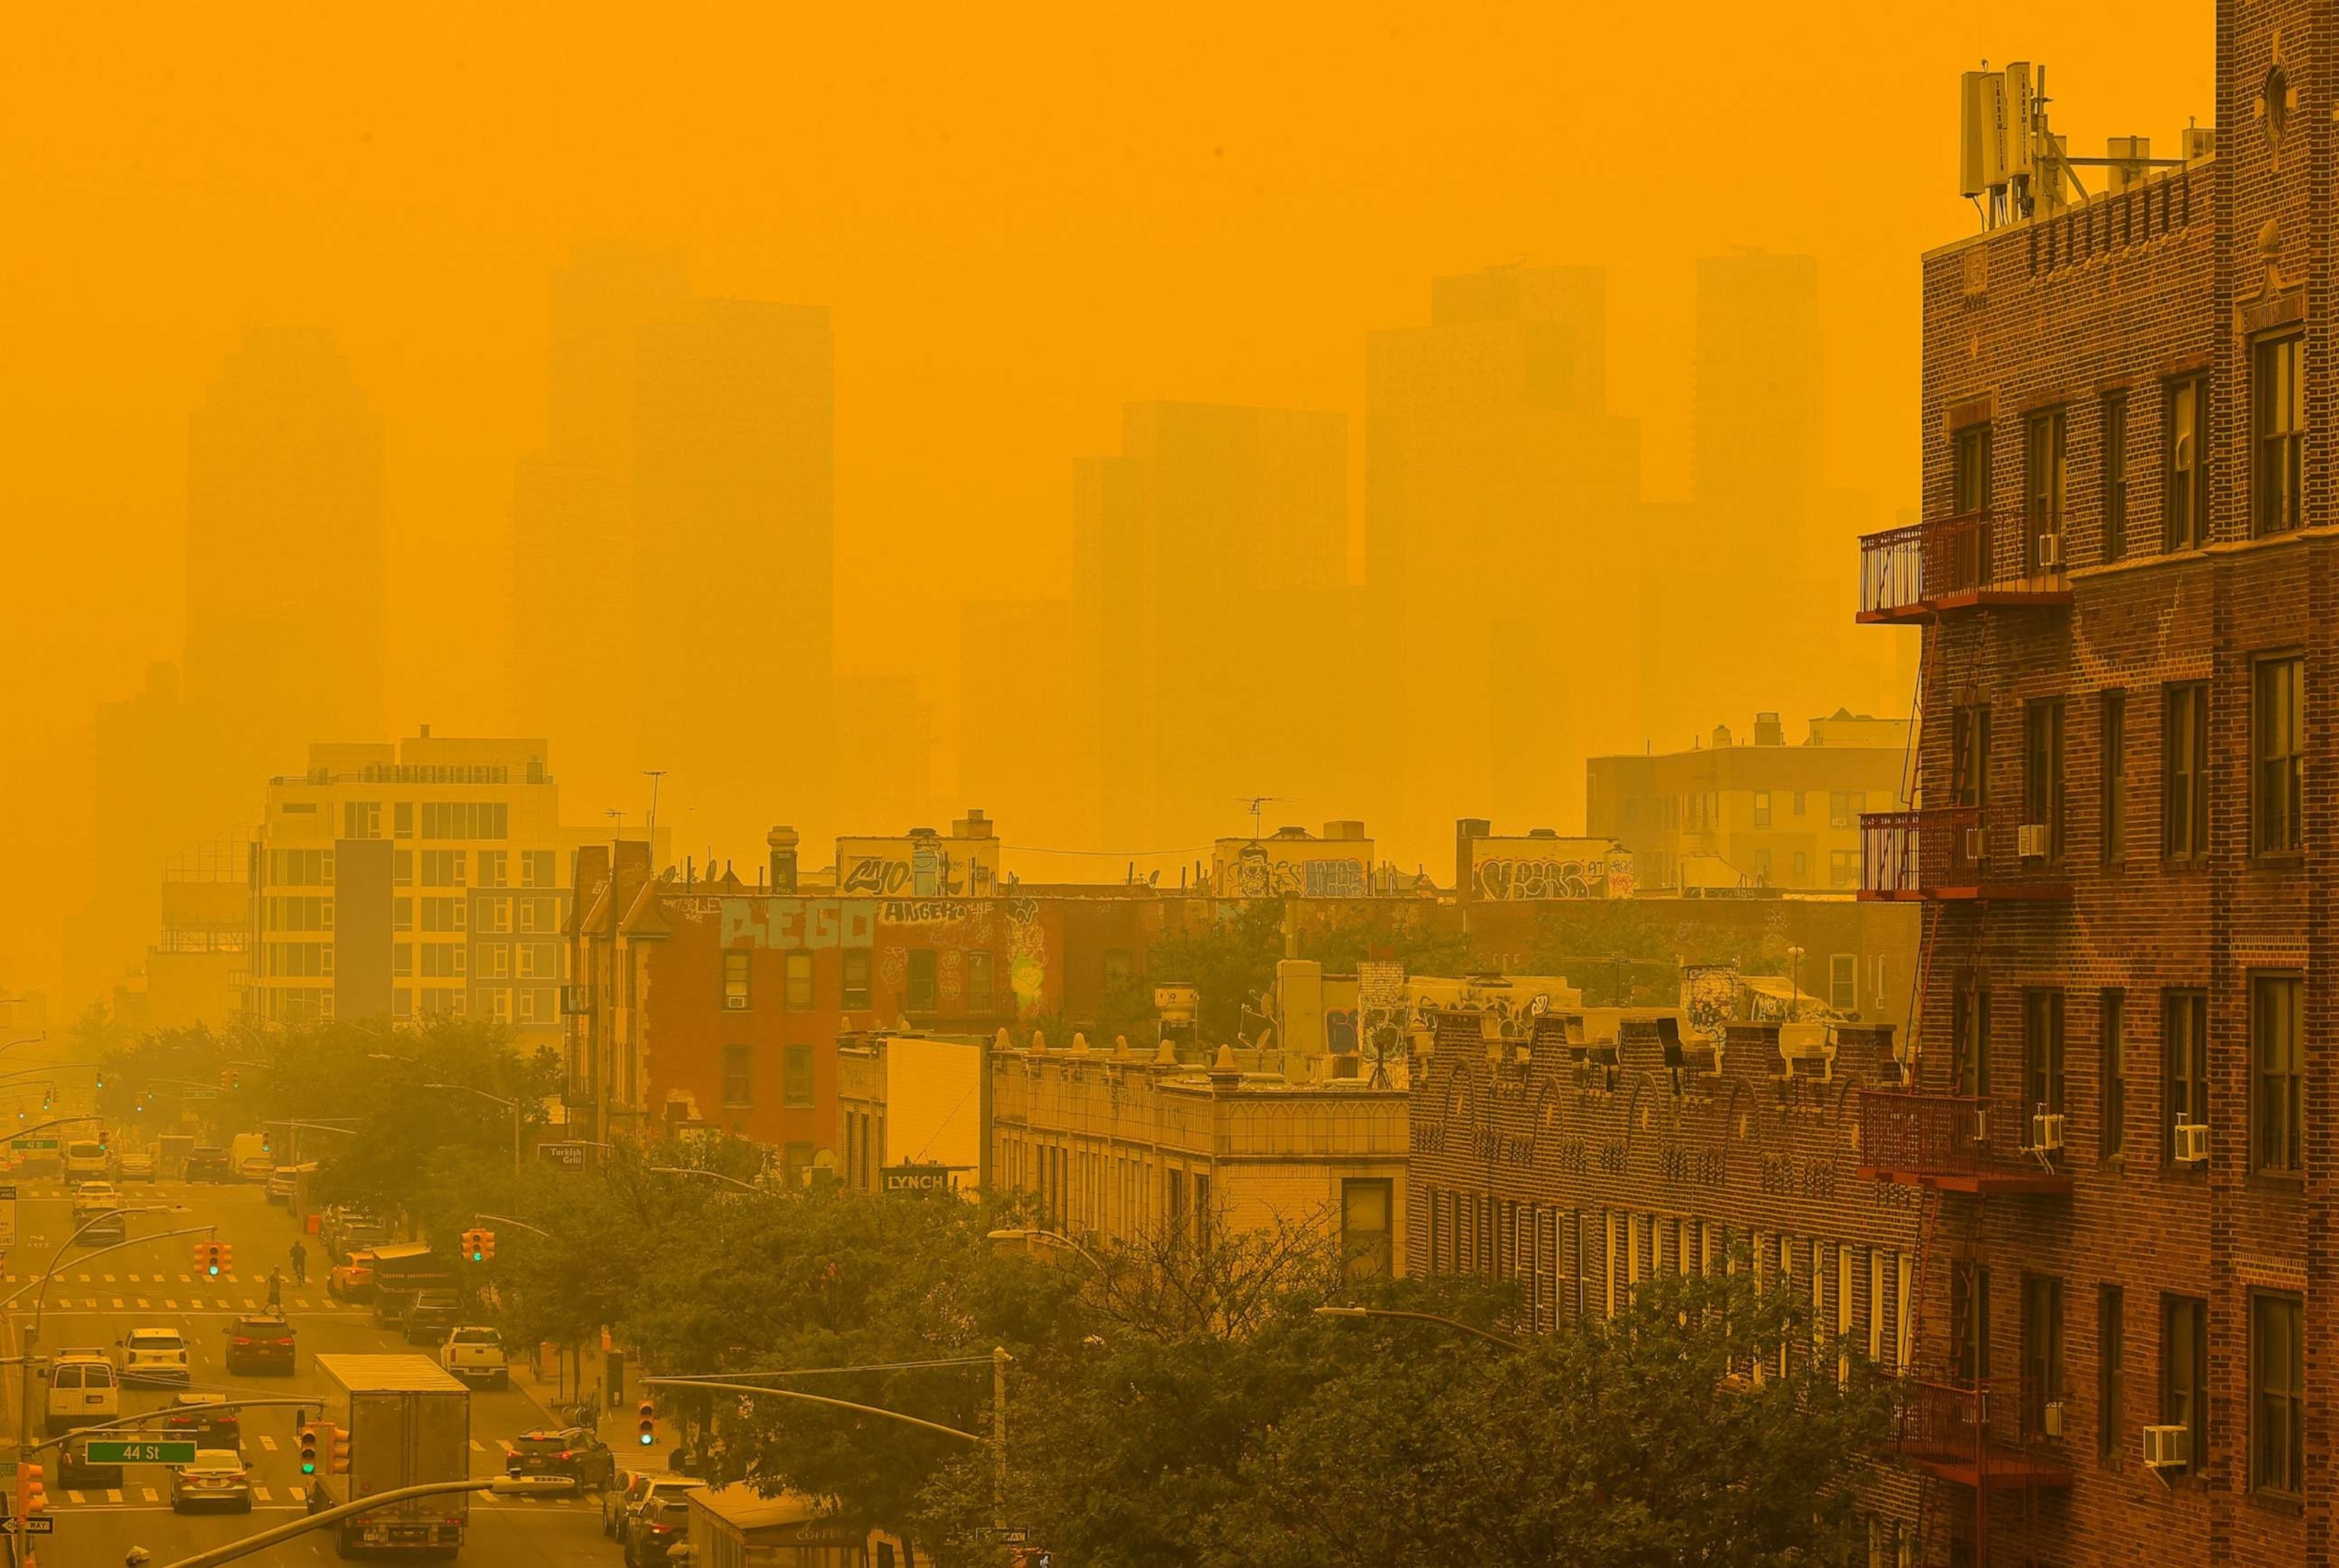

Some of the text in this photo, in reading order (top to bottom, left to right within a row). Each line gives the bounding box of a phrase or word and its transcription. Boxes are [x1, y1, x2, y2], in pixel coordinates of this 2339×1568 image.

[1996, 80, 2005, 171] TRANSMITTER
[563, 1155, 582, 1164] Grill
[888, 1175, 943, 1189] LYNCH
[123, 1445, 160, 1460] 44 St
